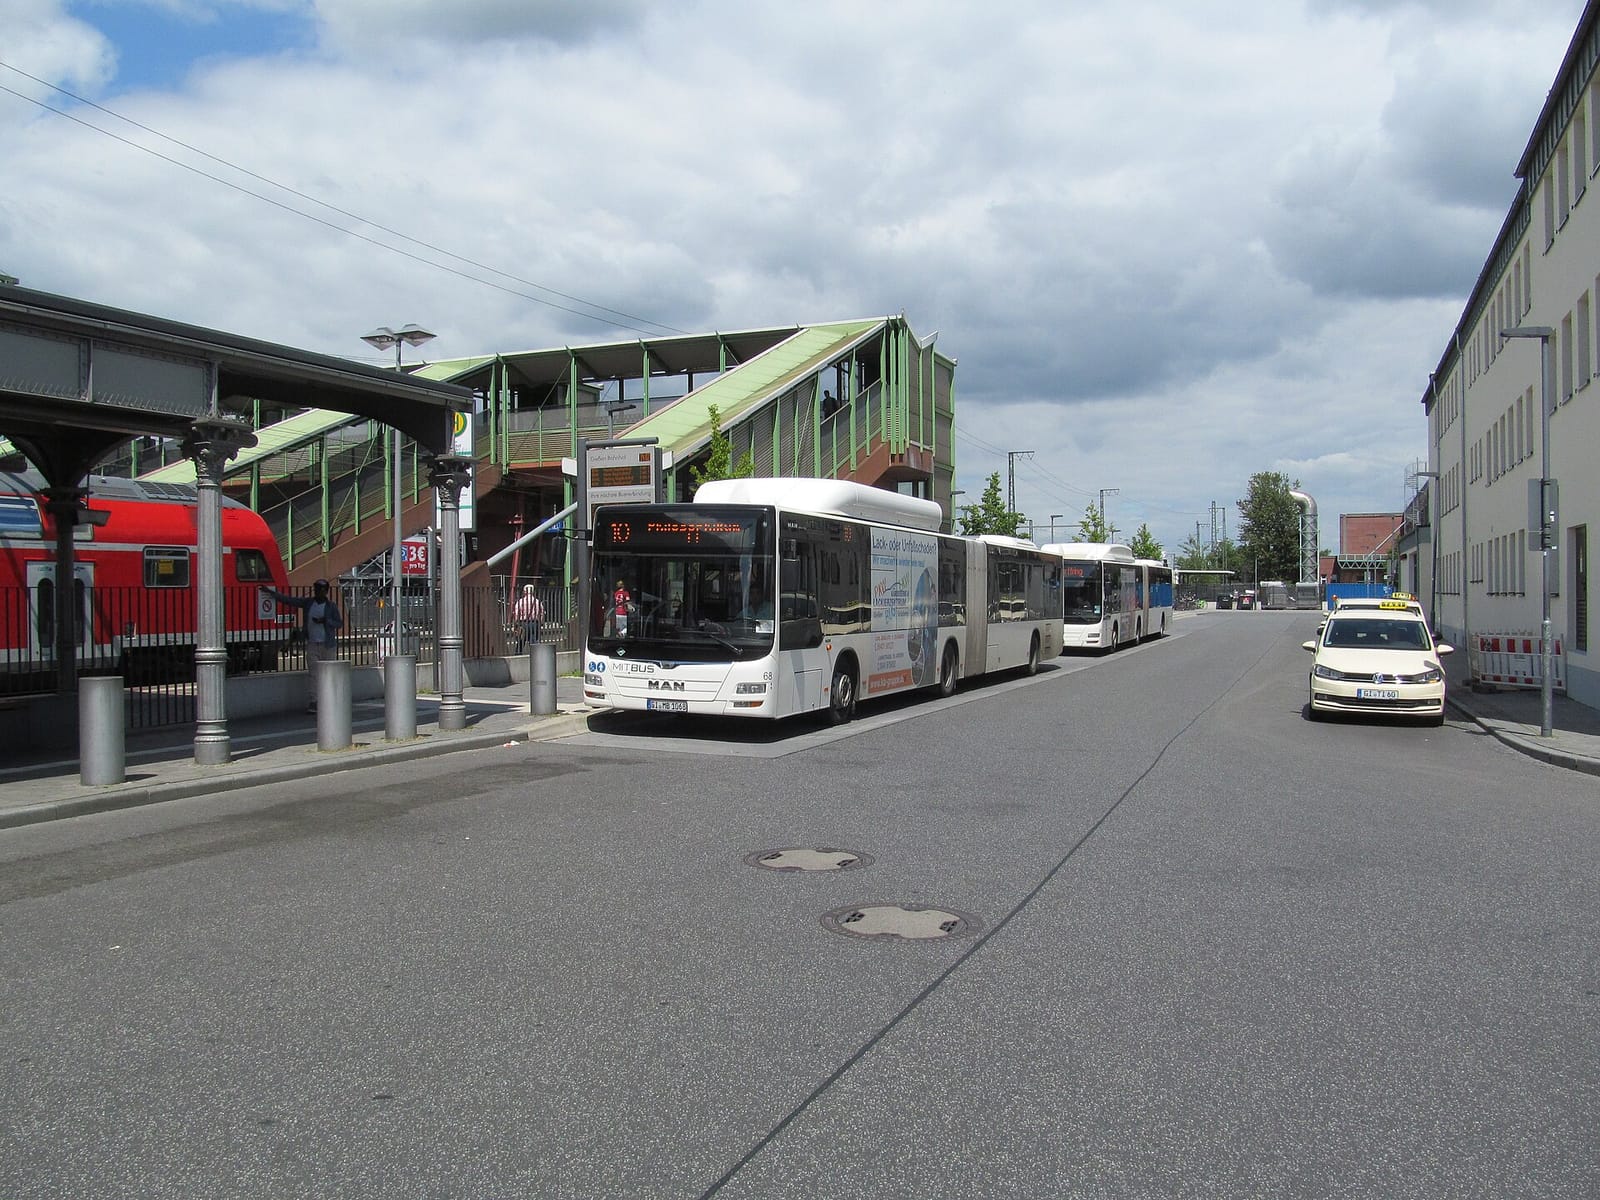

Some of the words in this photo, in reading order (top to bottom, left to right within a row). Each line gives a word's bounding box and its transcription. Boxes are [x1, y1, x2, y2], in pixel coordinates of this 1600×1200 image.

[611, 523, 631, 543] 10
[889, 537, 901, 551] oder
[409, 545, 426, 562] 3€
[612, 663, 655, 674] MITBUS
[763, 672, 773, 681] 68
[648, 680, 685, 691] MAN
